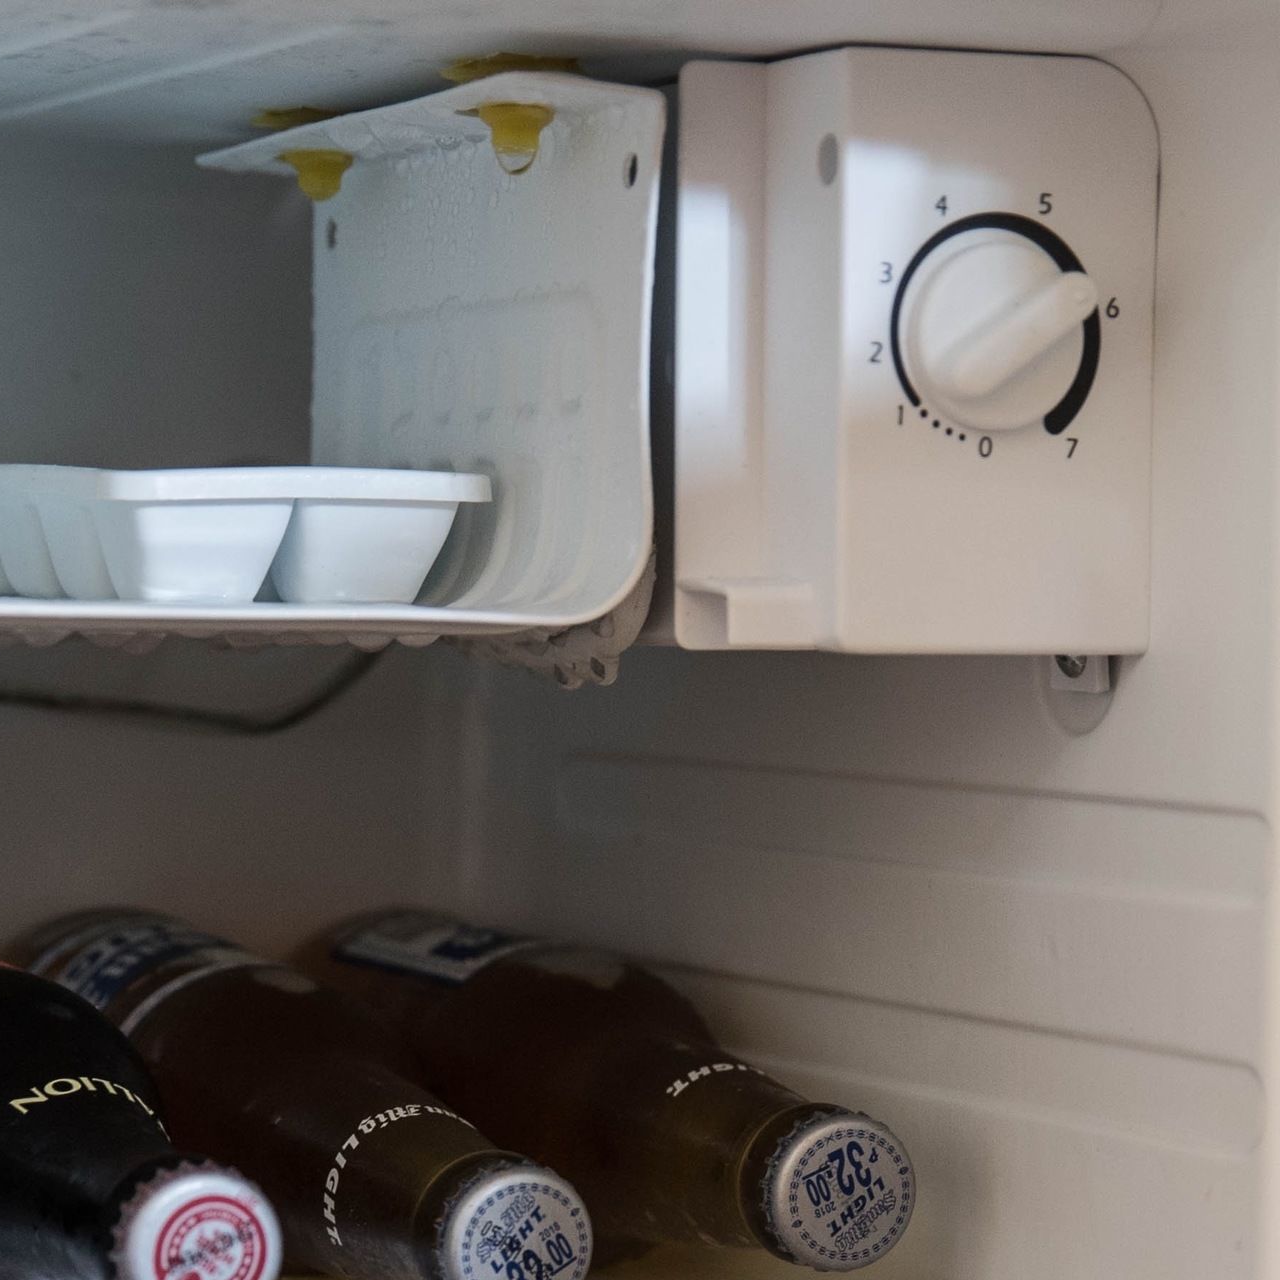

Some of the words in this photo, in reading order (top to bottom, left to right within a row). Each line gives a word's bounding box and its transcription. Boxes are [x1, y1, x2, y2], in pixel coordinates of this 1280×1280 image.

[935, 195, 948, 216] 4
[1038, 193, 1052, 214] 5
[879, 262, 893, 283] 3
[1106, 297, 1119, 318] 6
[868, 341, 883, 363] 2
[897, 404, 904, 425] 1
[978, 436, 993, 458] 0
[1066, 438, 1079, 459] 7
[814, 1201, 838, 1219] 2018
[538, 1221, 562, 1243] 2018
